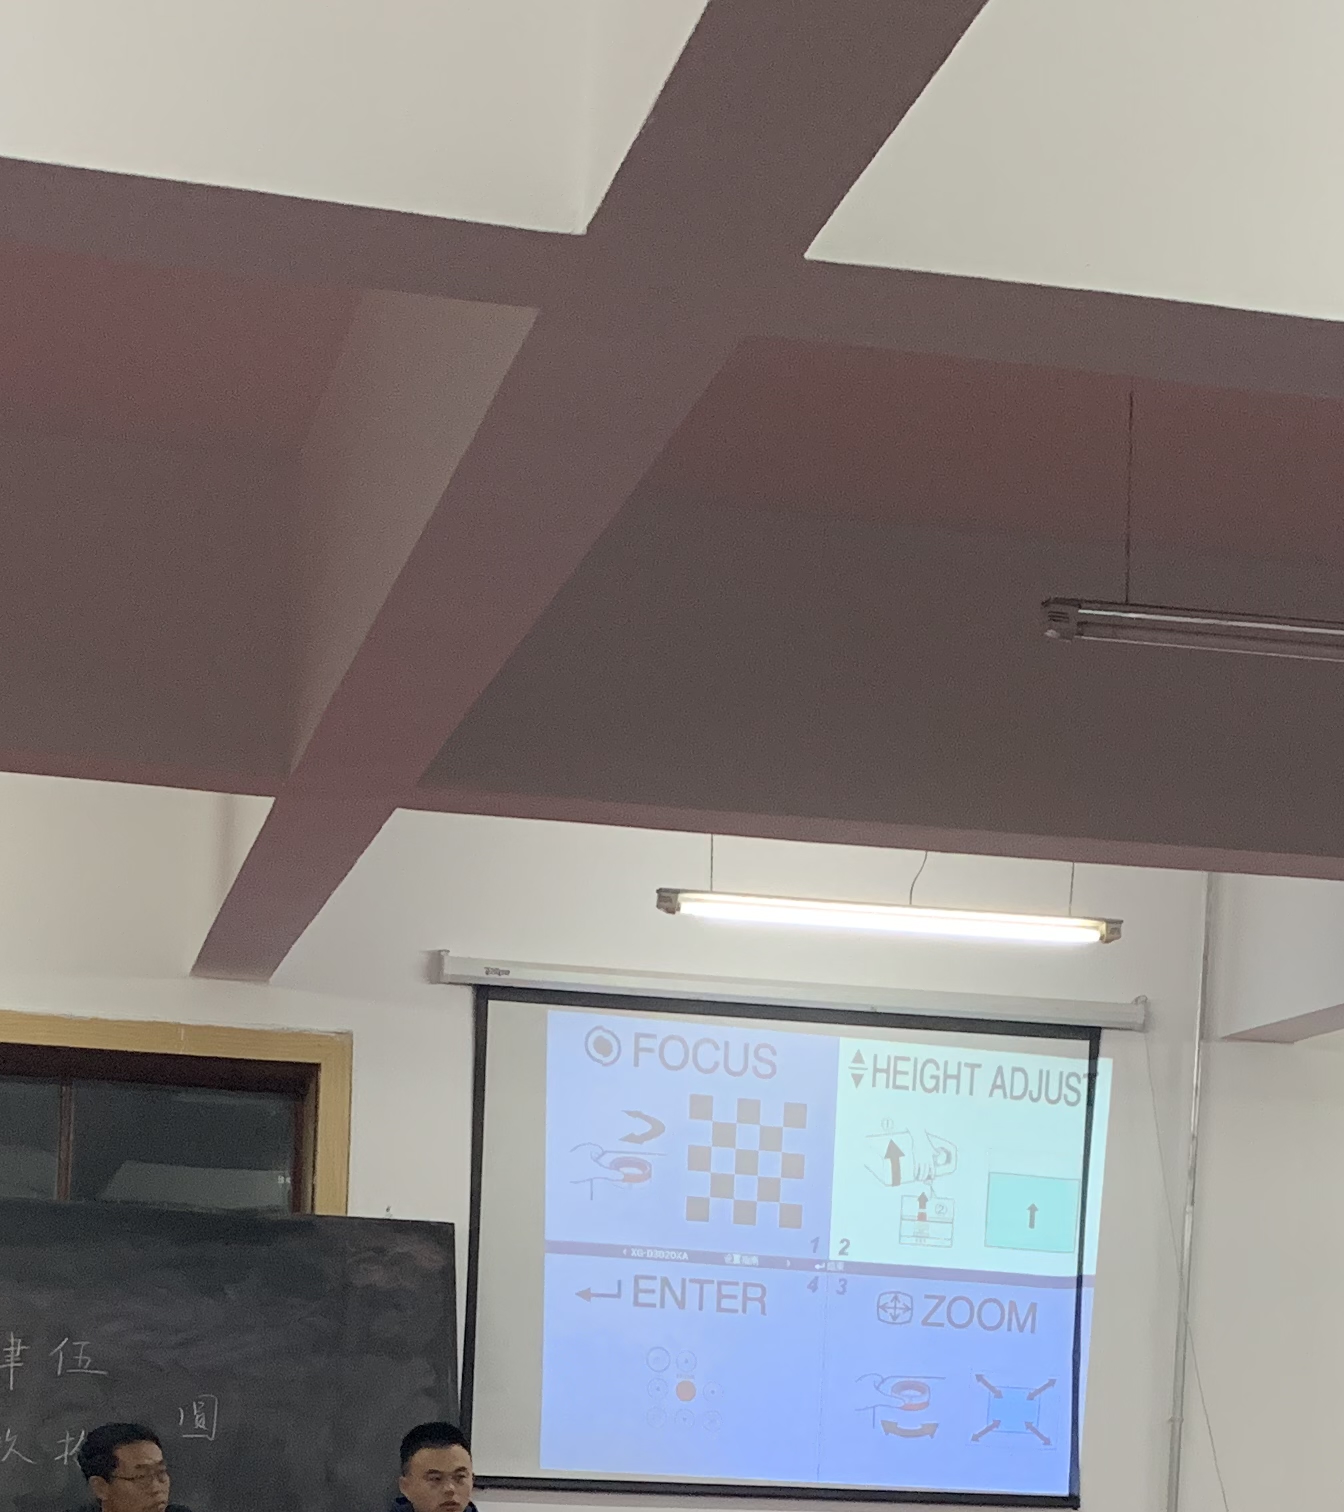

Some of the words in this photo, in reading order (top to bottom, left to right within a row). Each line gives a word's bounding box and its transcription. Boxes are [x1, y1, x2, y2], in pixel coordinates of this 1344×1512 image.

[632, 1032, 778, 1080] FOCUS
[870, 1053, 982, 1098] HEIGHT
[810, 1236, 820, 1254] 1
[838, 1237, 851, 1256] 2
[632, 1274, 768, 1316] ENTER
[806, 1275, 819, 1293] 4
[836, 1277, 848, 1295] 3
[920, 1294, 1038, 1335] ZOOM
